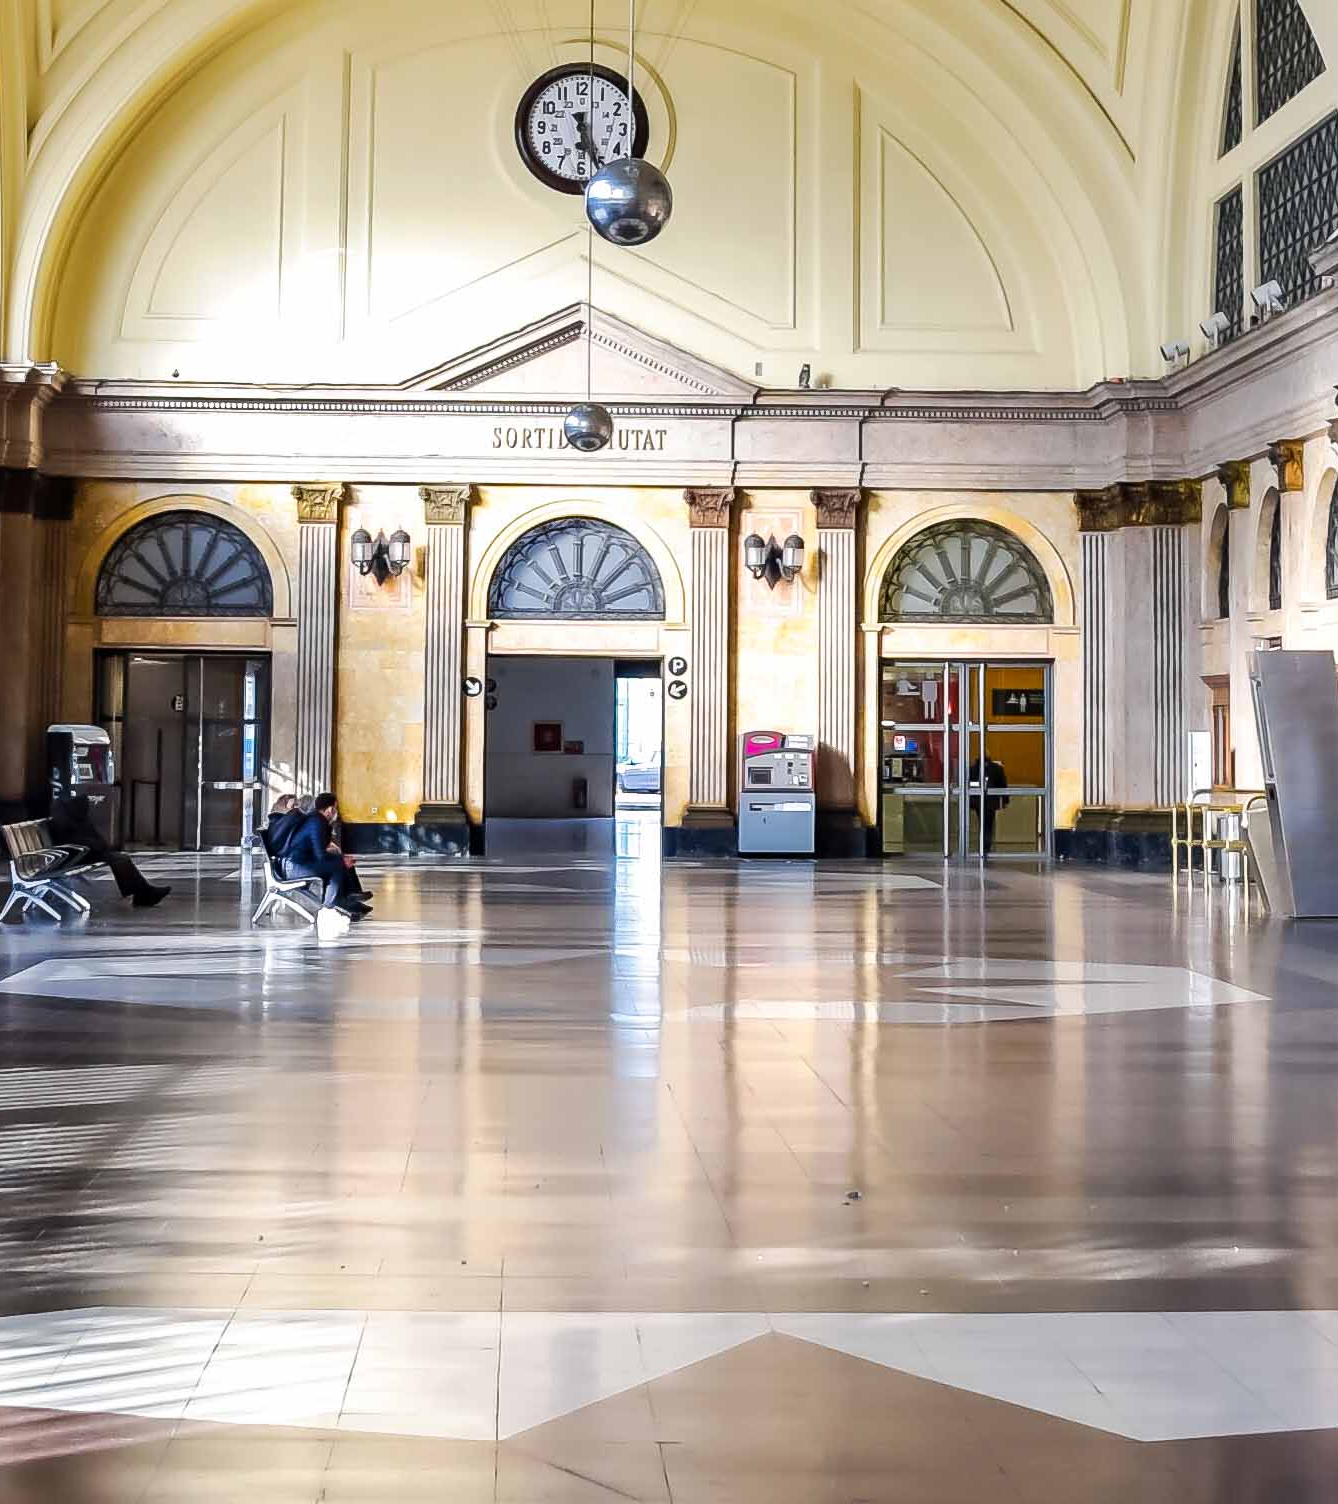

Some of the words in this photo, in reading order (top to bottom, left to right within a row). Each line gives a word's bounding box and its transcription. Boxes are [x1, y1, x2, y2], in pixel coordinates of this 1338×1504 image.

[557, 86, 568, 101] 11
[576, 81, 589, 96] 12
[600, 87, 605, 101] 1
[543, 100, 556, 115] 10
[612, 102, 622, 117] 2
[537, 120, 546, 134] 9
[618, 123, 628, 137] 3
[542, 141, 551, 155] 8
[613, 142, 621, 156] 4
[556, 155, 566, 170] 7
[577, 161, 586, 176] 6
[492, 427, 574, 449] SORTID
[606, 429, 668, 450] IUTAT
[672, 658, 684, 674] P
